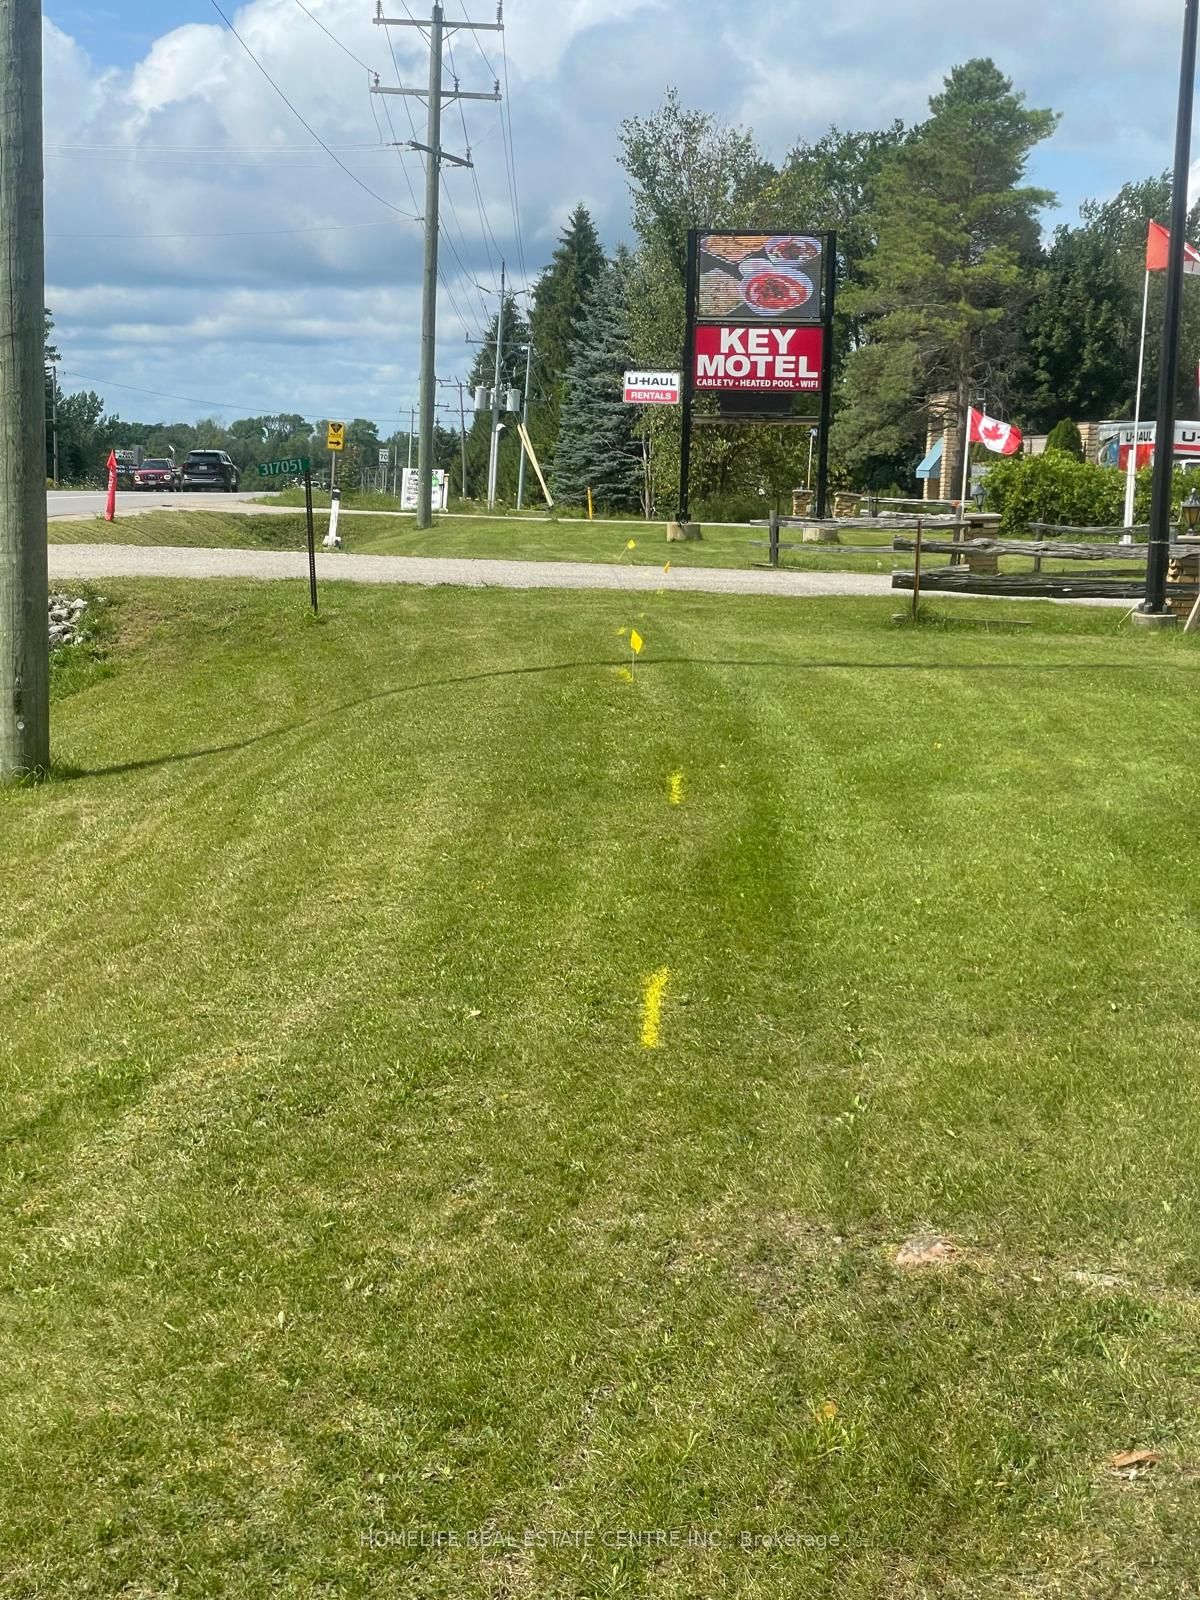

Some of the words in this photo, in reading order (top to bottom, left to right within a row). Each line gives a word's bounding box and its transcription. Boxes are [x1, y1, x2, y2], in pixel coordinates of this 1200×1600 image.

[720, 328, 796, 354] KEY
[697, 355, 818, 378] MOTEL
[627, 376, 676, 386] U-HAUL
[696, 378, 721, 386] CABLE
[723, 379, 734, 387] TV
[740, 379, 771, 387] HEATED
[772, 380, 794, 388] POOL
[800, 380, 818, 388] WIFI
[631, 391, 672, 400] RENTALS
[1126, 431, 1152, 442] U-AUL
[260, 459, 303, 476] 317051
